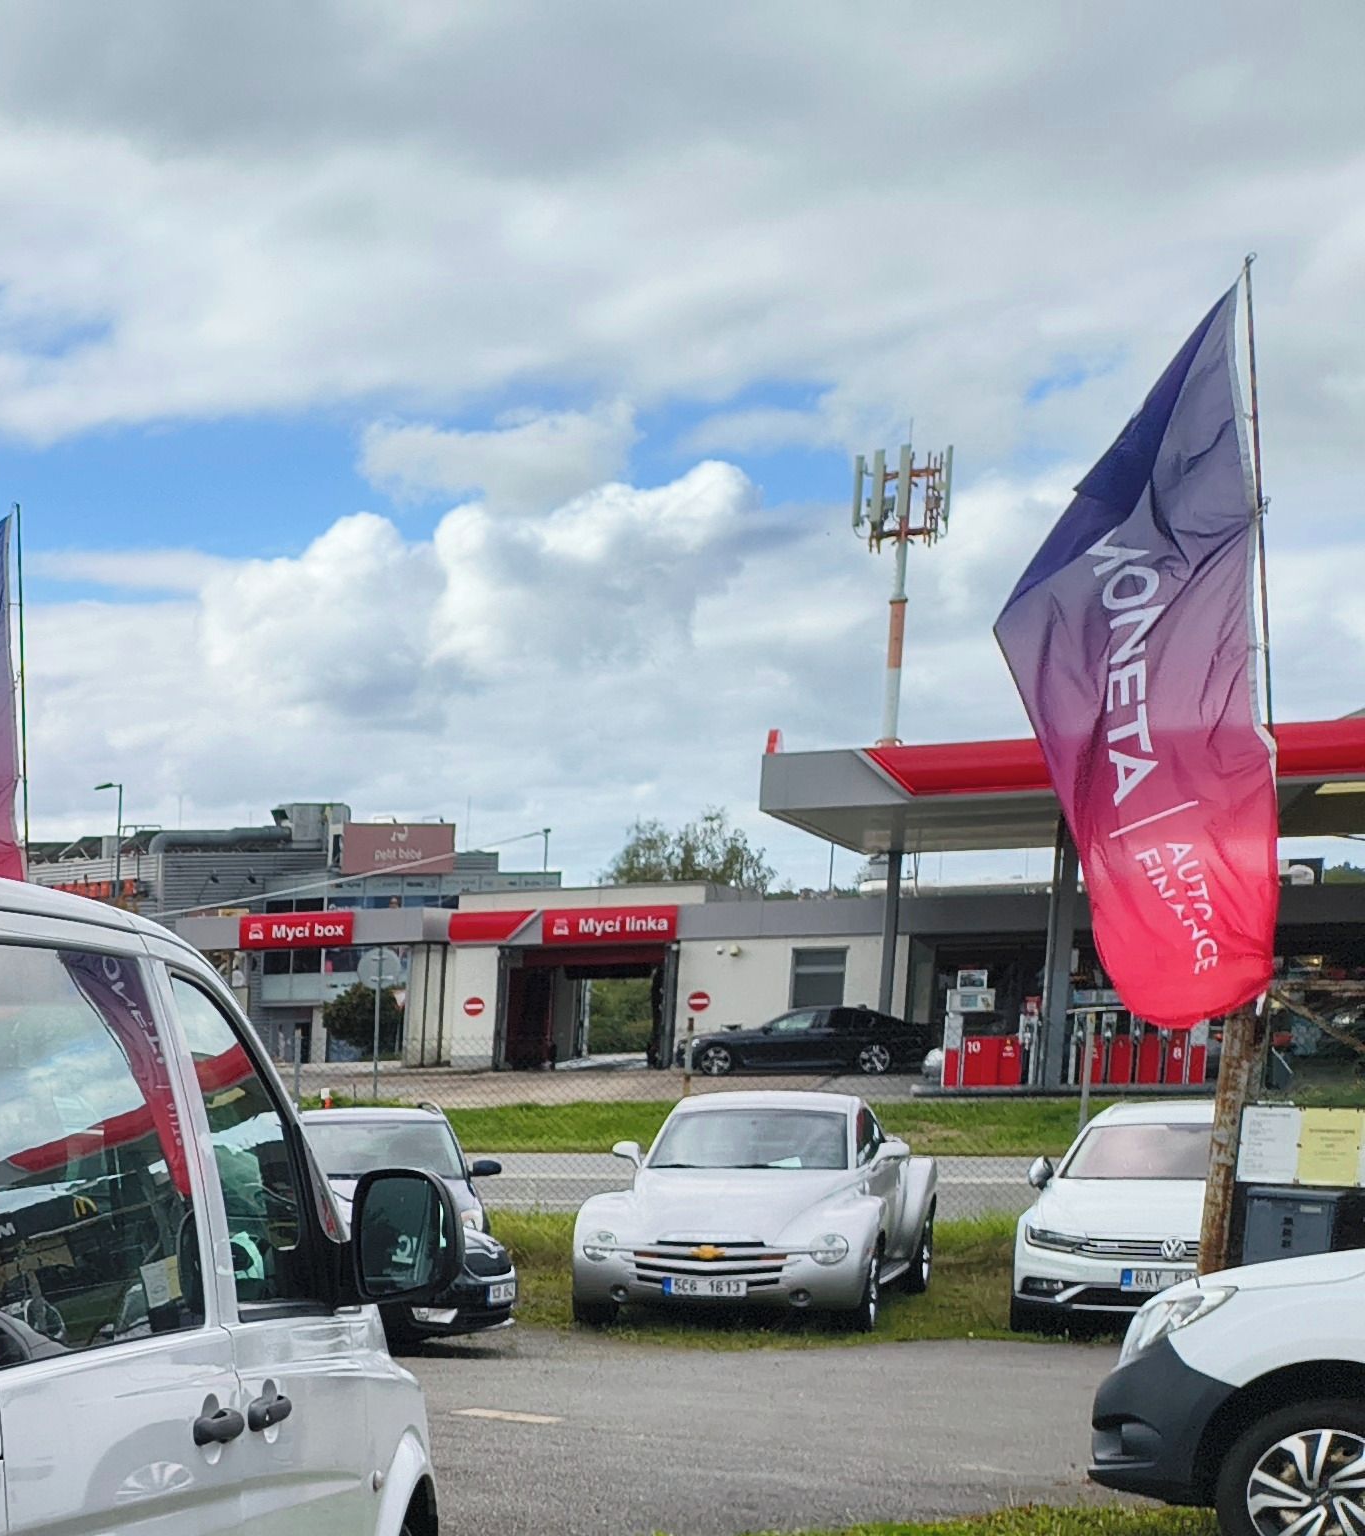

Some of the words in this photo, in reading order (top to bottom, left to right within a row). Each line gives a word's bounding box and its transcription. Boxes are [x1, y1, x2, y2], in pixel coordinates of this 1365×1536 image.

[314, 922, 344, 938] box
[625, 915, 669, 932] linka
[967, 1040, 981, 1054] 10
